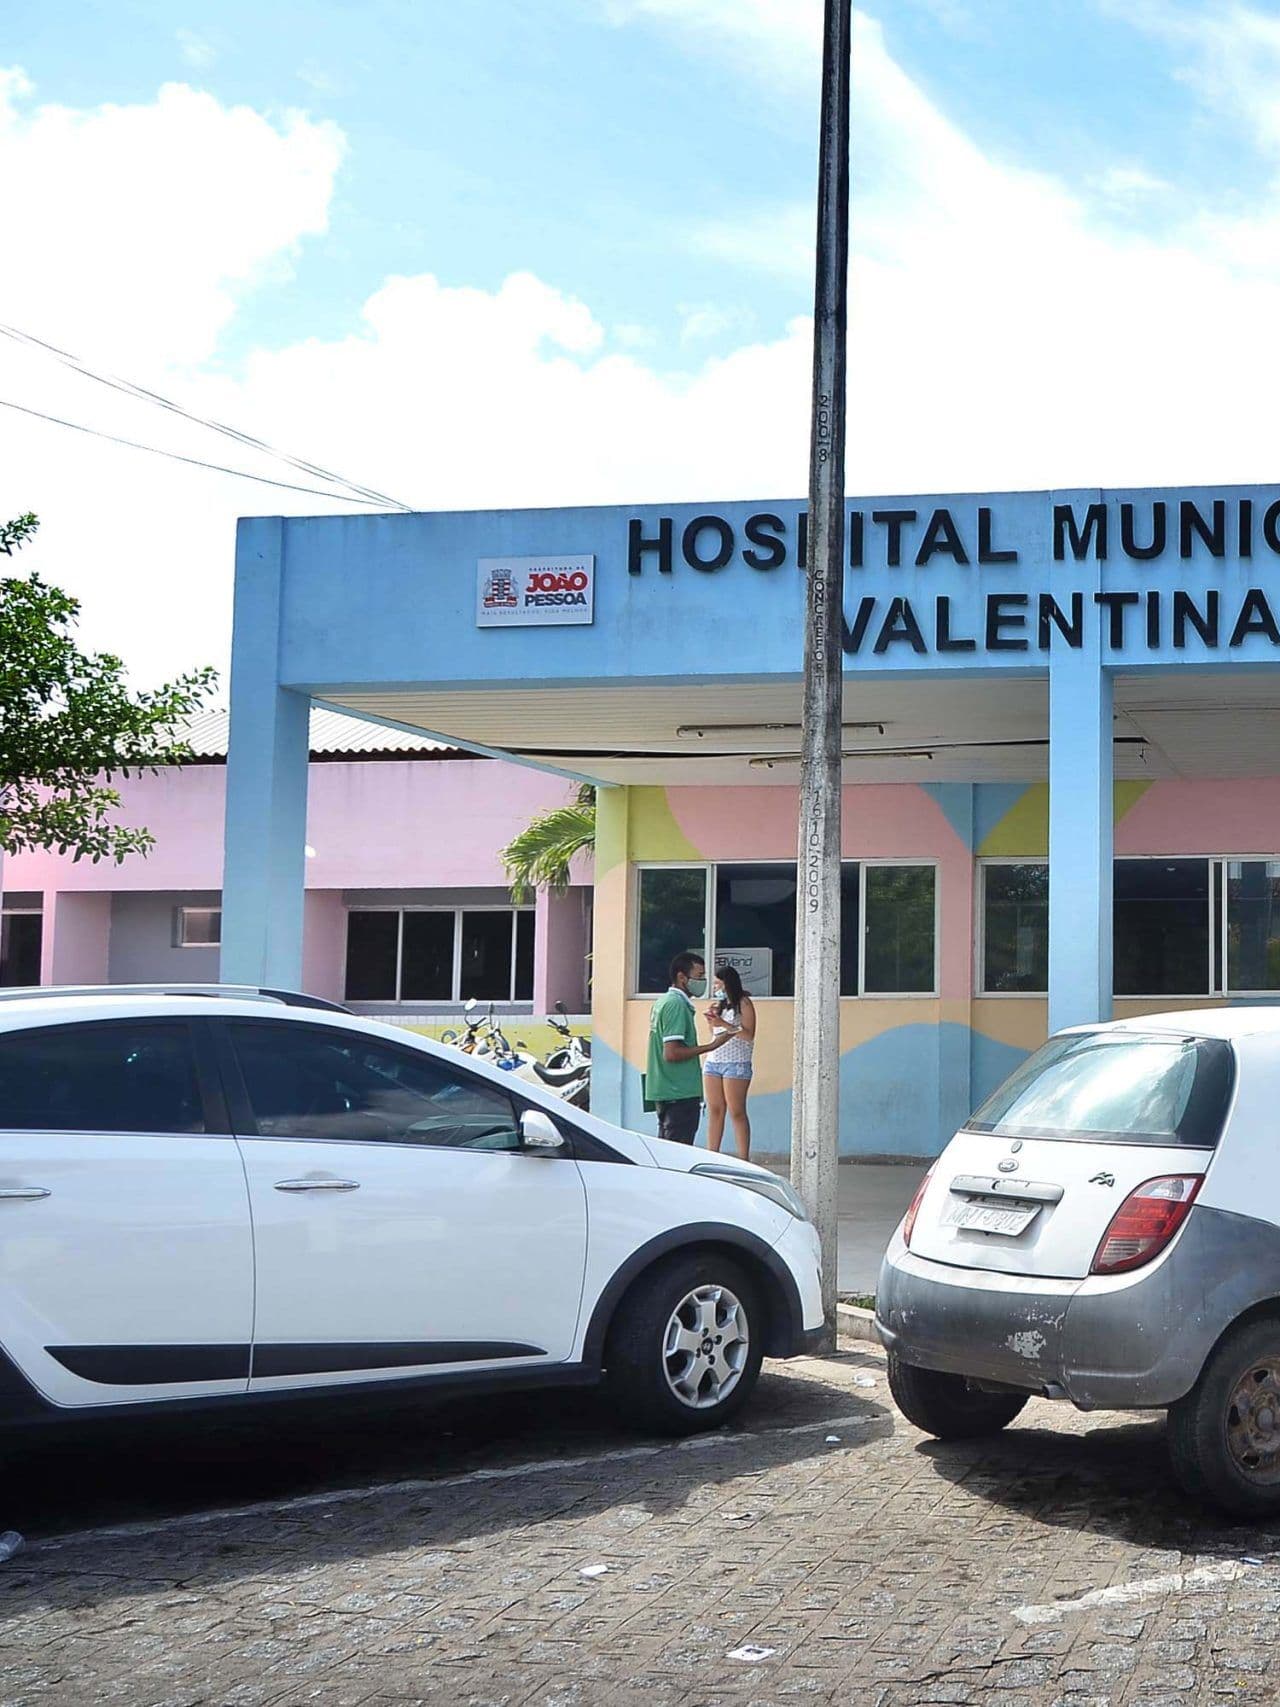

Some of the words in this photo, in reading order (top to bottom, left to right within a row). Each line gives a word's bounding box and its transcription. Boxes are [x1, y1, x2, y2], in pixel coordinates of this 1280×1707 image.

[628, 506, 1018, 575] HOSITAL
[526, 571, 588, 593] JOÃO
[525, 592, 587, 607] PESSOA
